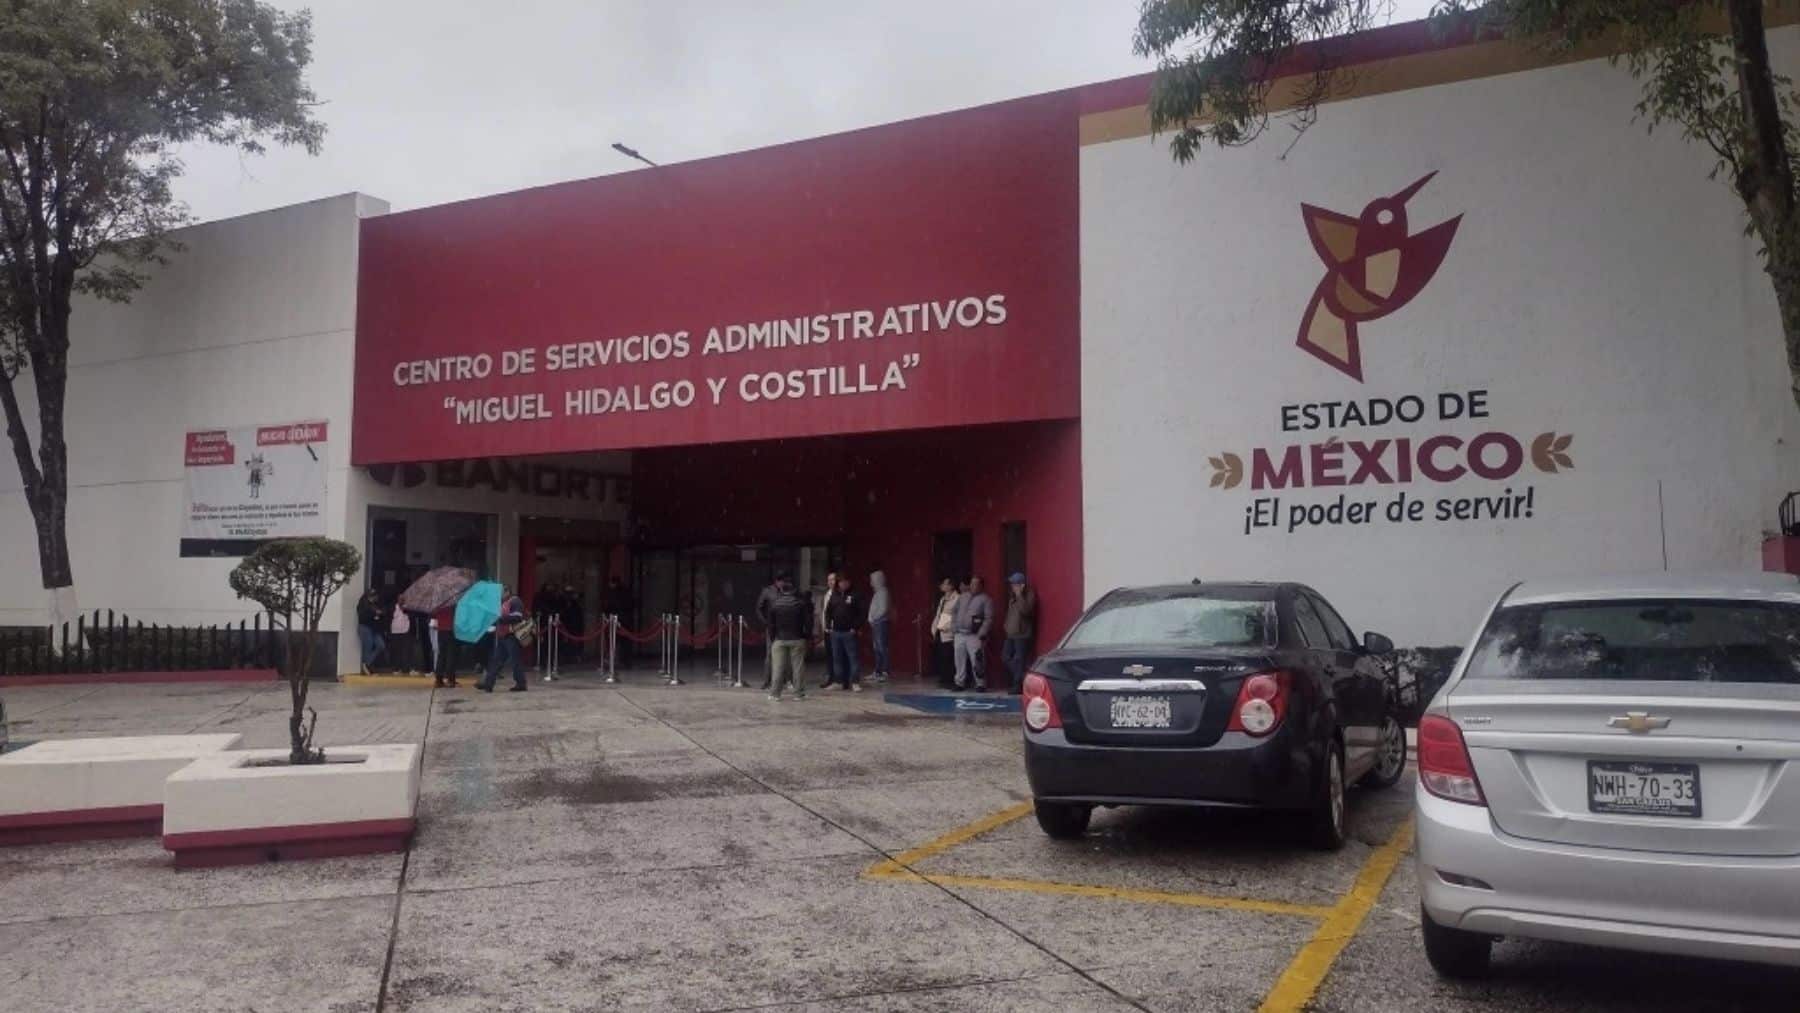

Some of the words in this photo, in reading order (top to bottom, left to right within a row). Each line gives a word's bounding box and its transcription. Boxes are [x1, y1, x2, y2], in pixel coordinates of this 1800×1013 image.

[393, 353, 493, 387] CENTRO
[502, 348, 536, 375] DE
[545, 330, 690, 371] SERVICIOS
[701, 294, 1008, 356] ADMINISTRATIVOS
[443, 393, 553, 425] “MIGUEL
[565, 379, 696, 416] HIDALGO
[706, 377, 728, 405] Y
[739, 352, 920, 402] COSTILLA”
[1280, 394, 1426, 433] ESTADO
[1437, 389, 1491, 421] DE
[1250, 431, 1525, 491] MÉXICO
[1244, 498, 1279, 535] ¡El
[1288, 494, 1377, 534] poder
[1386, 492, 1426, 523] de
[1435, 486, 1535, 522] servir!
[1592, 774, 1697, 800] NWH-70-33
